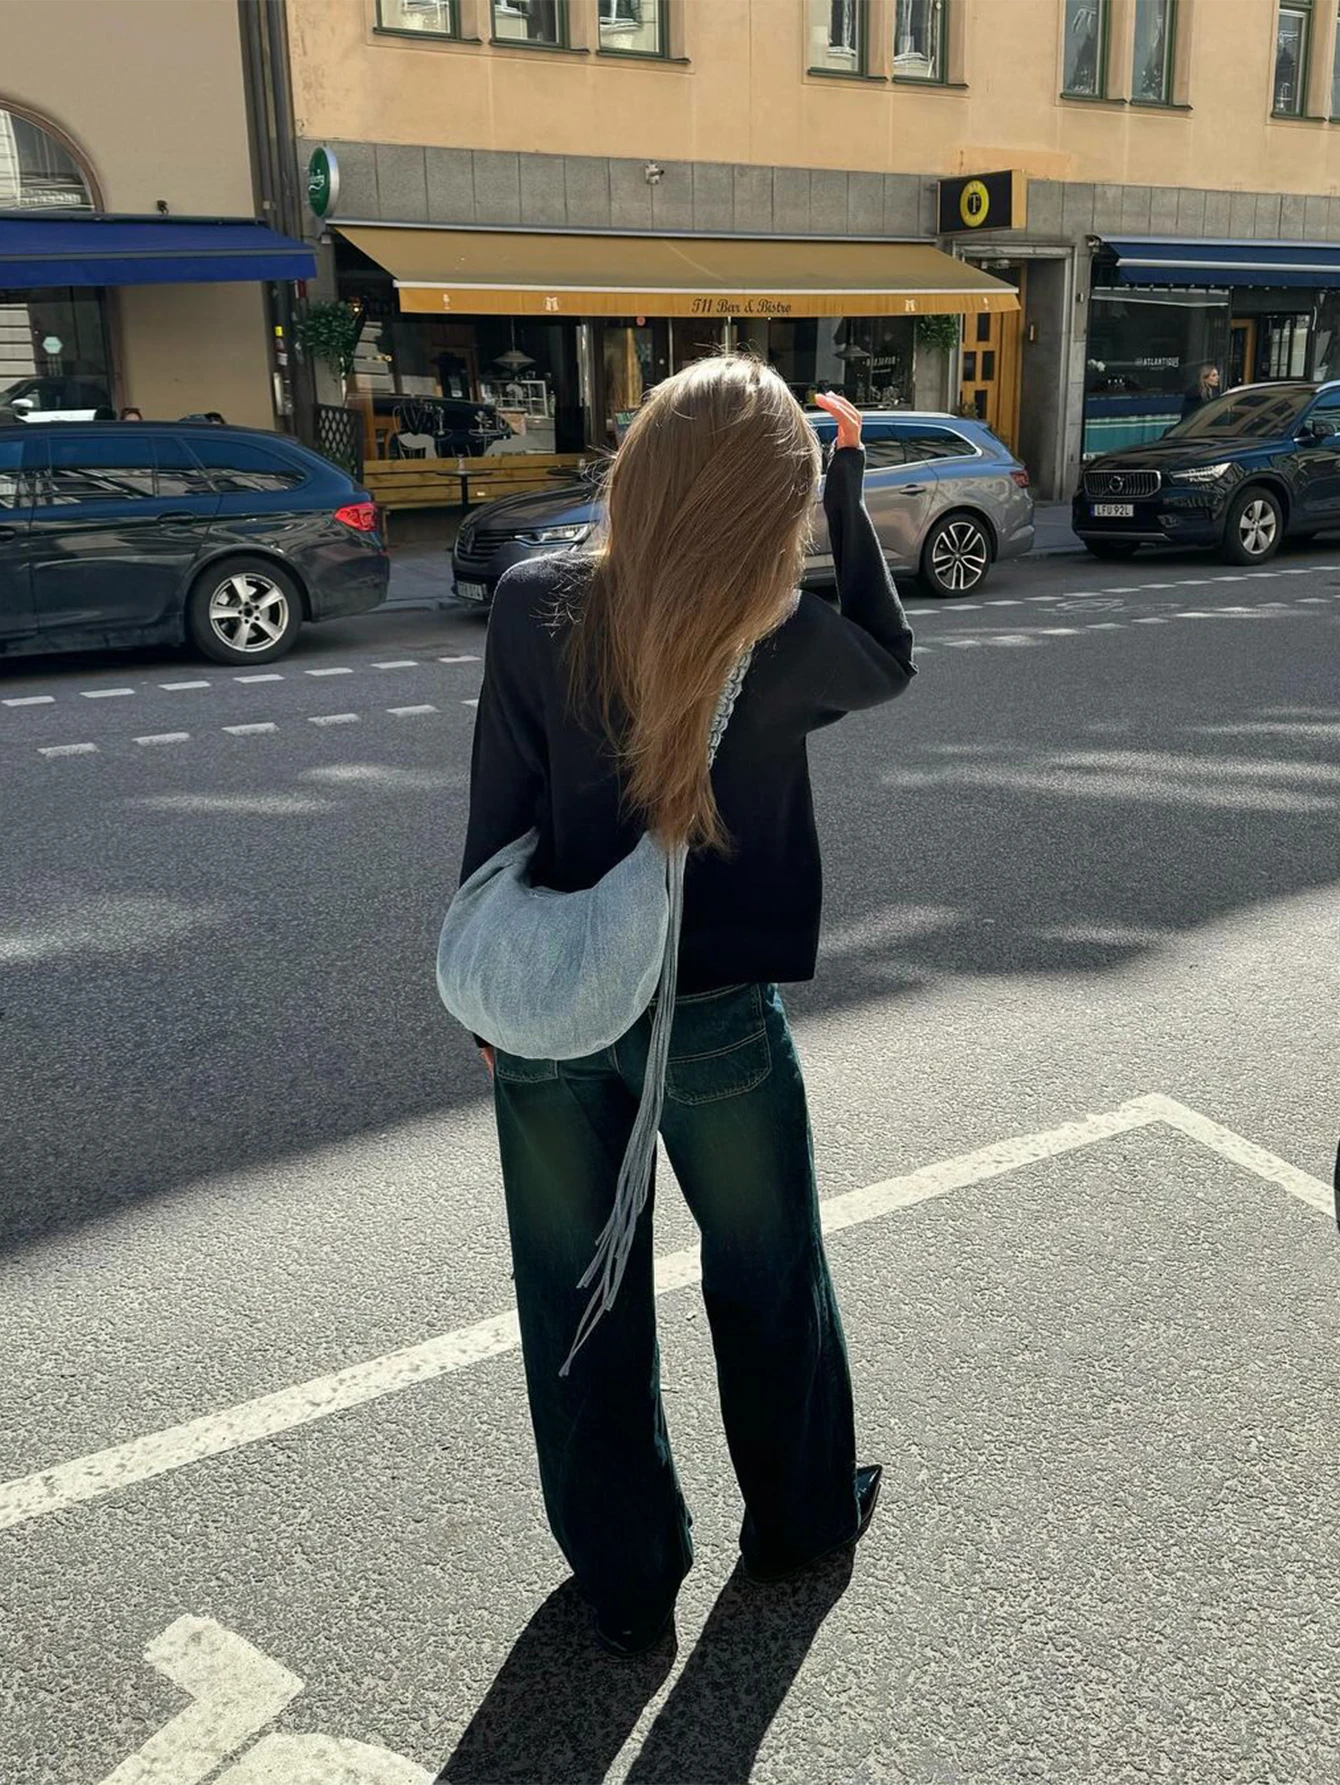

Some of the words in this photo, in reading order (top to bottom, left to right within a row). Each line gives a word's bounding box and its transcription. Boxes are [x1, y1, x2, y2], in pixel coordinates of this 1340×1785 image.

[716, 299, 740, 313] Bar
[744, 299, 754, 313] &
[757, 299, 792, 313] Bistro
